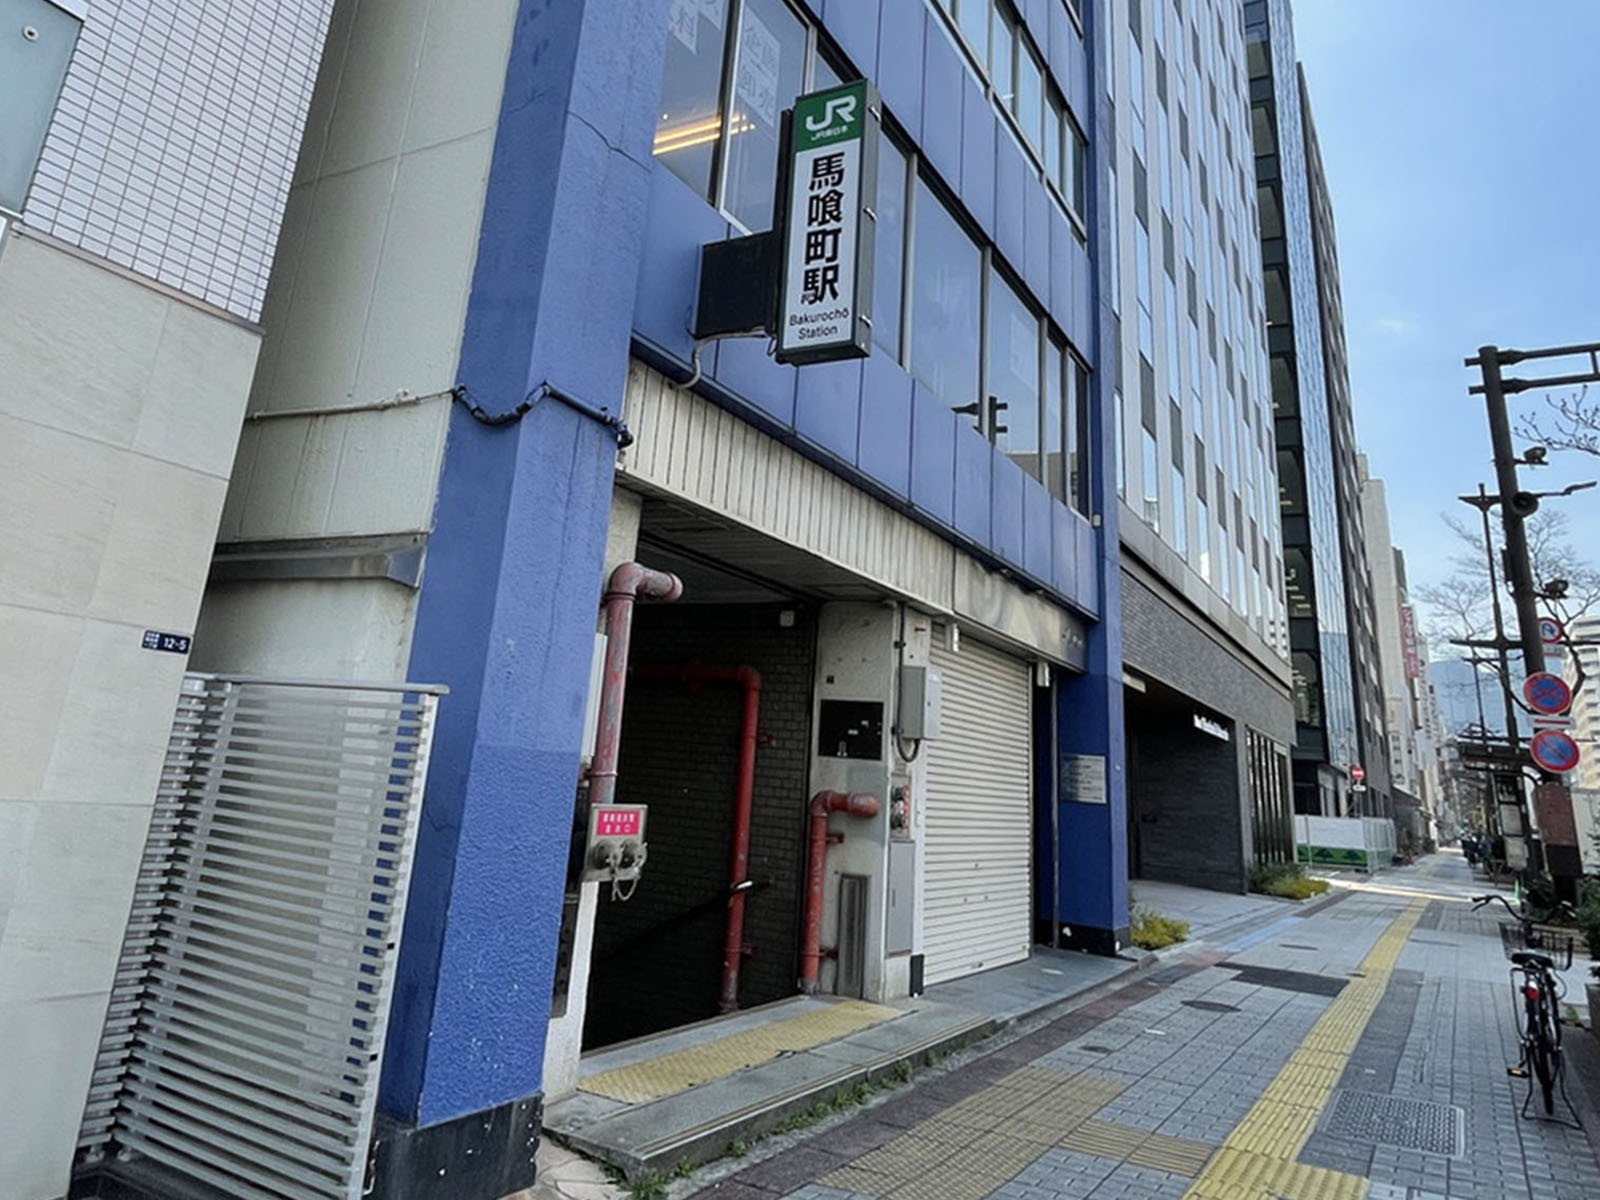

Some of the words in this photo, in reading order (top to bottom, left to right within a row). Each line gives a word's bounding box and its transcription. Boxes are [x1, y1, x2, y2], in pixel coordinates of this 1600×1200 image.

[805, 95, 857, 132] JR
[801, 152, 845, 306] 馬喰町駅
[798, 324, 838, 341] Station
